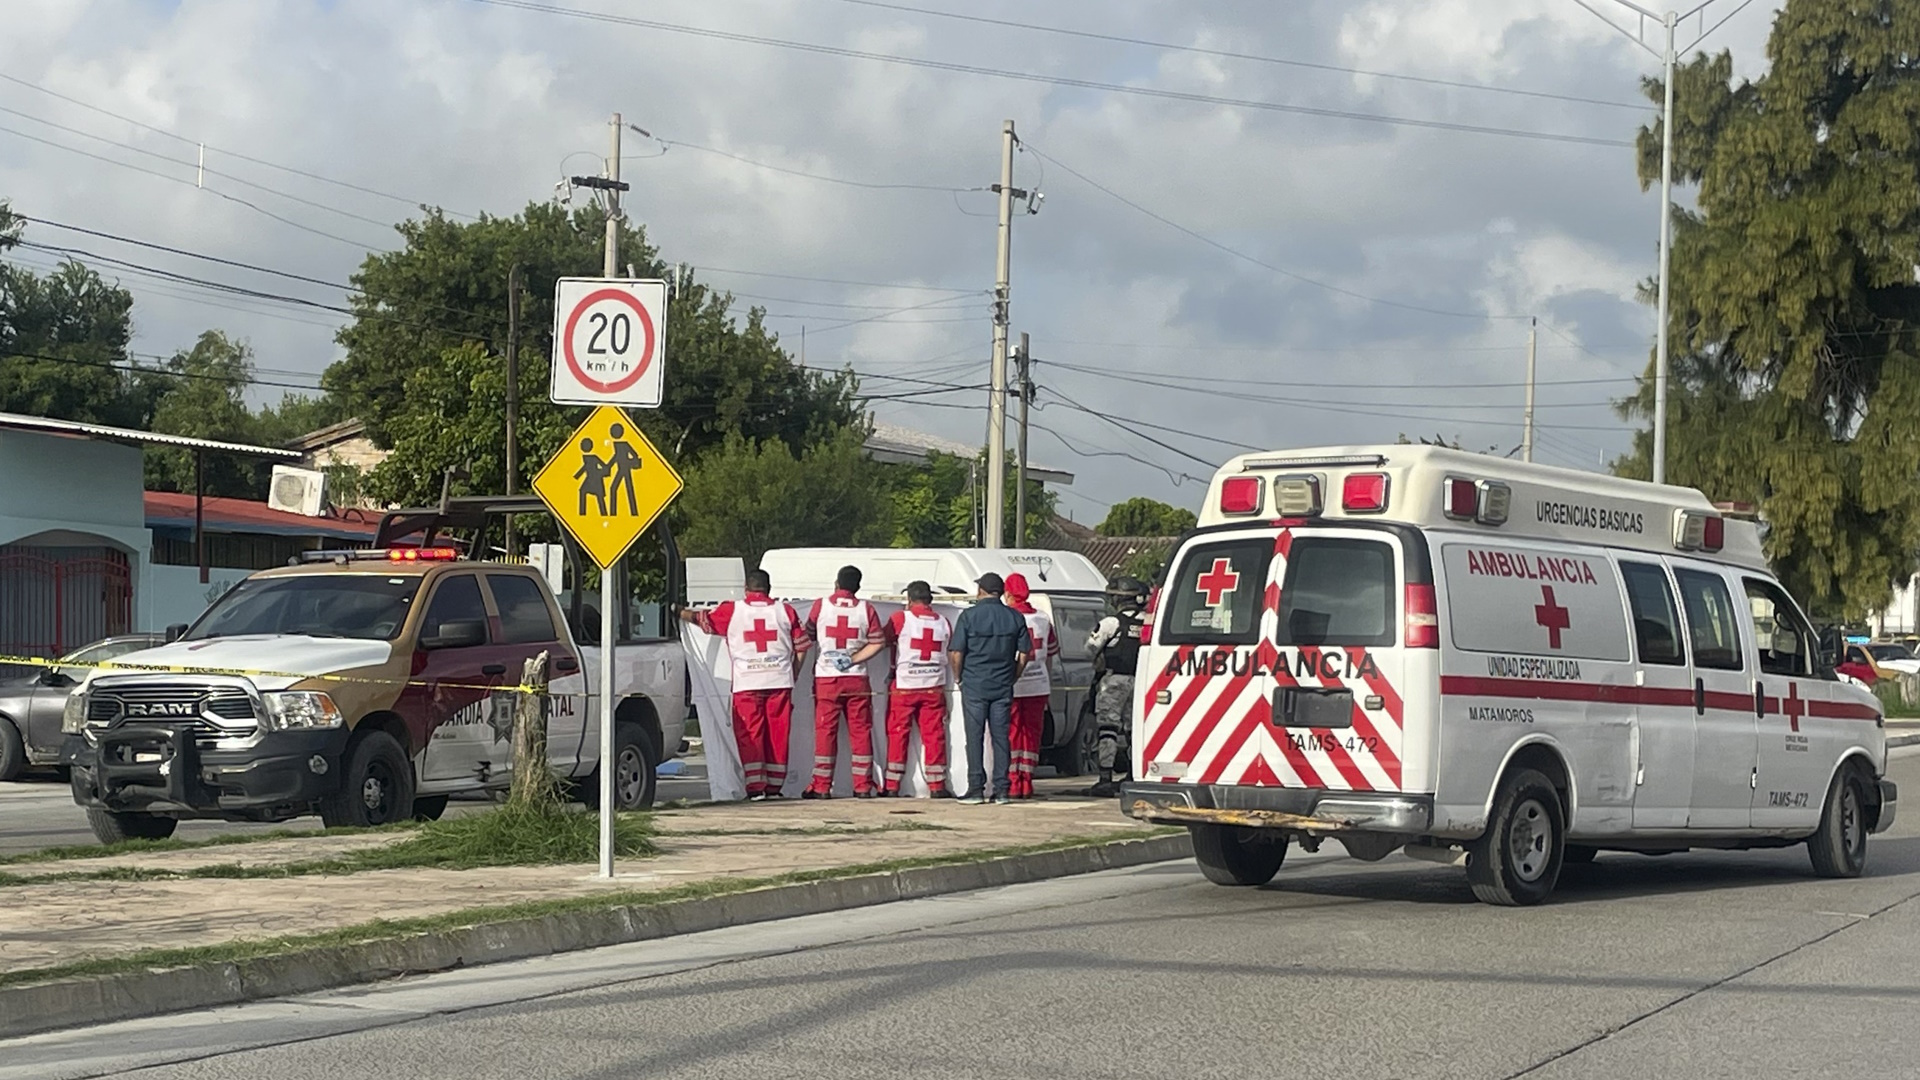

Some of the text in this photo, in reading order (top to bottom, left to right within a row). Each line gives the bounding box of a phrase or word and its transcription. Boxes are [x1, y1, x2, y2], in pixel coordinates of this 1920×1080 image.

[587, 312, 631, 355] 20
[586, 360, 629, 372] km/h
[1536, 501, 1643, 534] URGENCIAS BASICAS
[1467, 549, 1597, 585] AMBULANCIA
[1165, 651, 1378, 679] AMBULANCIA
[1487, 656, 1582, 680] UNIDAD ESPECIALIZADA
[128, 703, 193, 715] RAM
[1469, 707, 1534, 723] MATAMOROS
[1286, 733, 1378, 753] TAMS-472
[1769, 791, 1809, 807] TAMS-472
